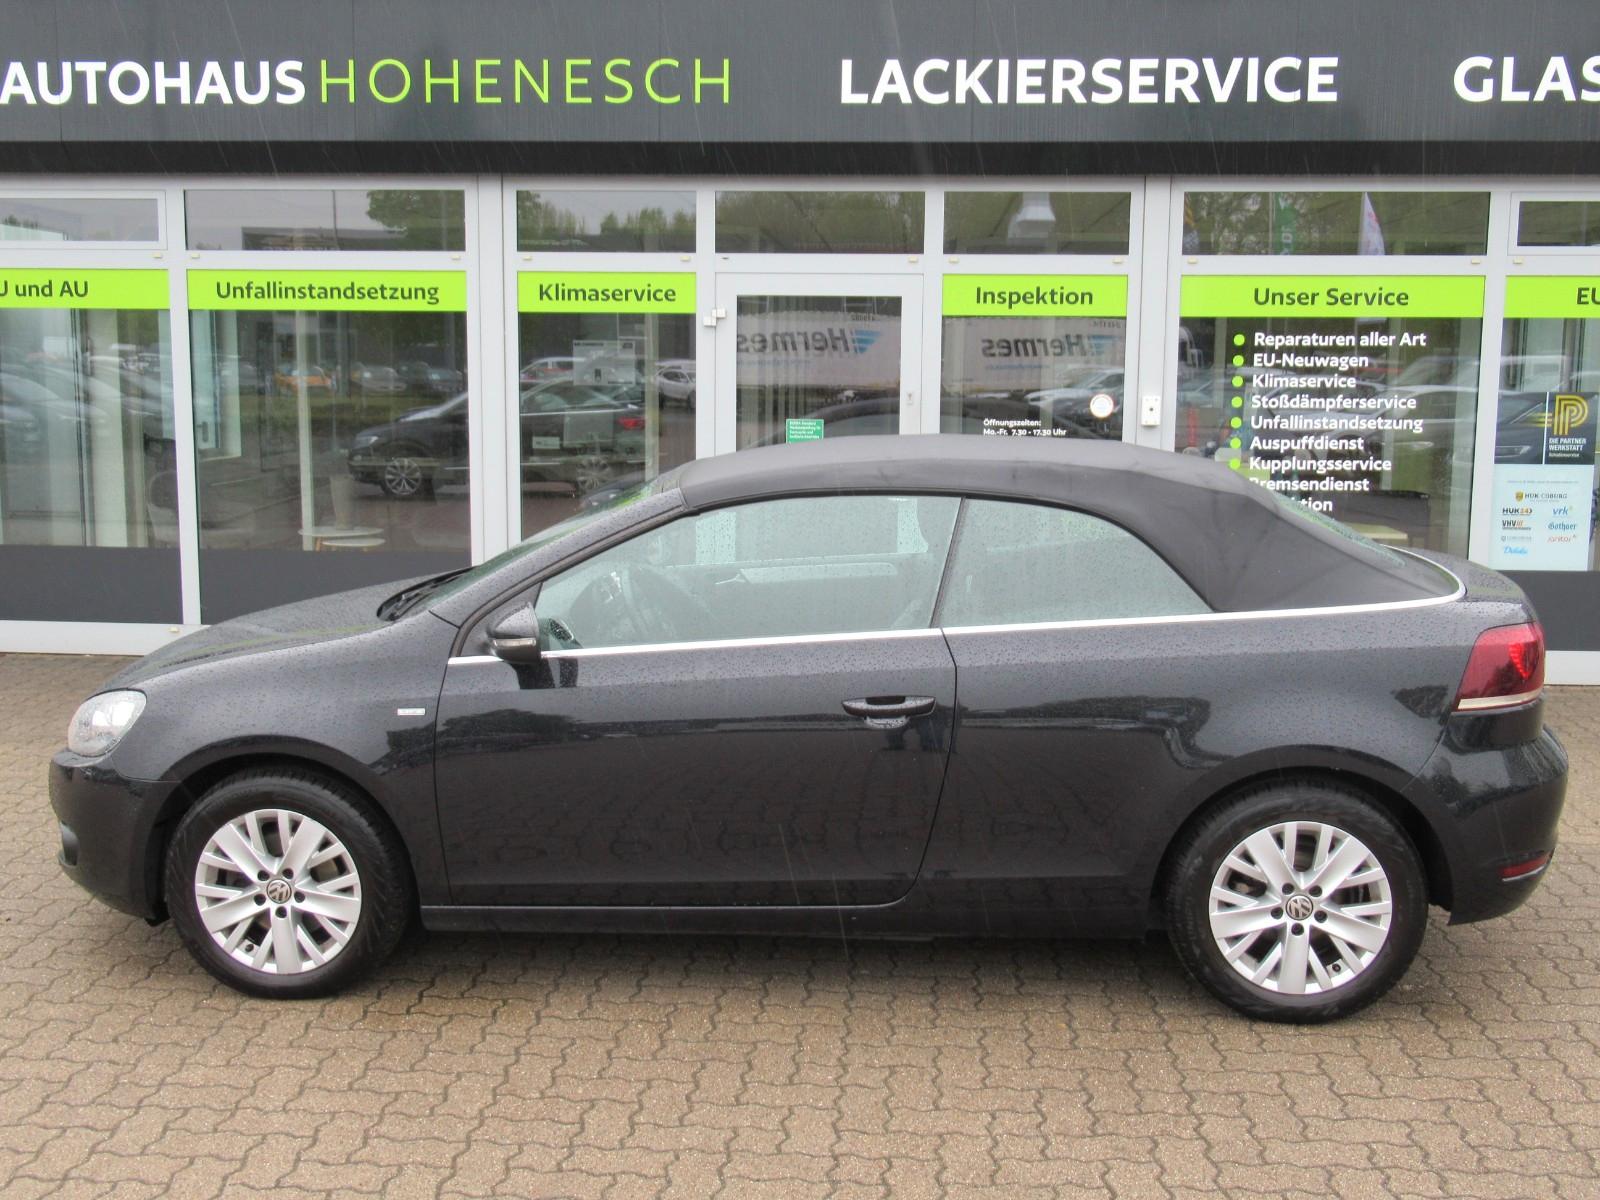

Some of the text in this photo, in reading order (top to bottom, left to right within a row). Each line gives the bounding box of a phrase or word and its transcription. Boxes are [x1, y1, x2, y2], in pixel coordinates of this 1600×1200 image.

[0, 57, 731, 105] AUTOHAUS HOHENESCH
[840, 57, 1338, 104] LACKIERSERVICE
[15, 280, 52, 297] und
[60, 281, 88, 298] AU
[216, 281, 440, 305] Unfallinstandsetzung
[539, 283, 676, 302] Klimaservice
[976, 287, 1093, 309] Inspektion
[1254, 287, 1408, 305] Unser Service
[1254, 332, 1427, 349] Reparaturen aller Art
[1253, 353, 1369, 370] EU-Neuwagen
[1252, 373, 1357, 388] Klimaservice
[1251, 394, 1417, 411] Stoßdämpferservice
[983, 418, 1041, 428] Öffnungszeiten:
[1251, 415, 1424, 433] Unfallinstandsetzung
[1250, 435, 1364, 451] Auspuffdienst
[1249, 456, 1392, 474] Kupplungsservice
